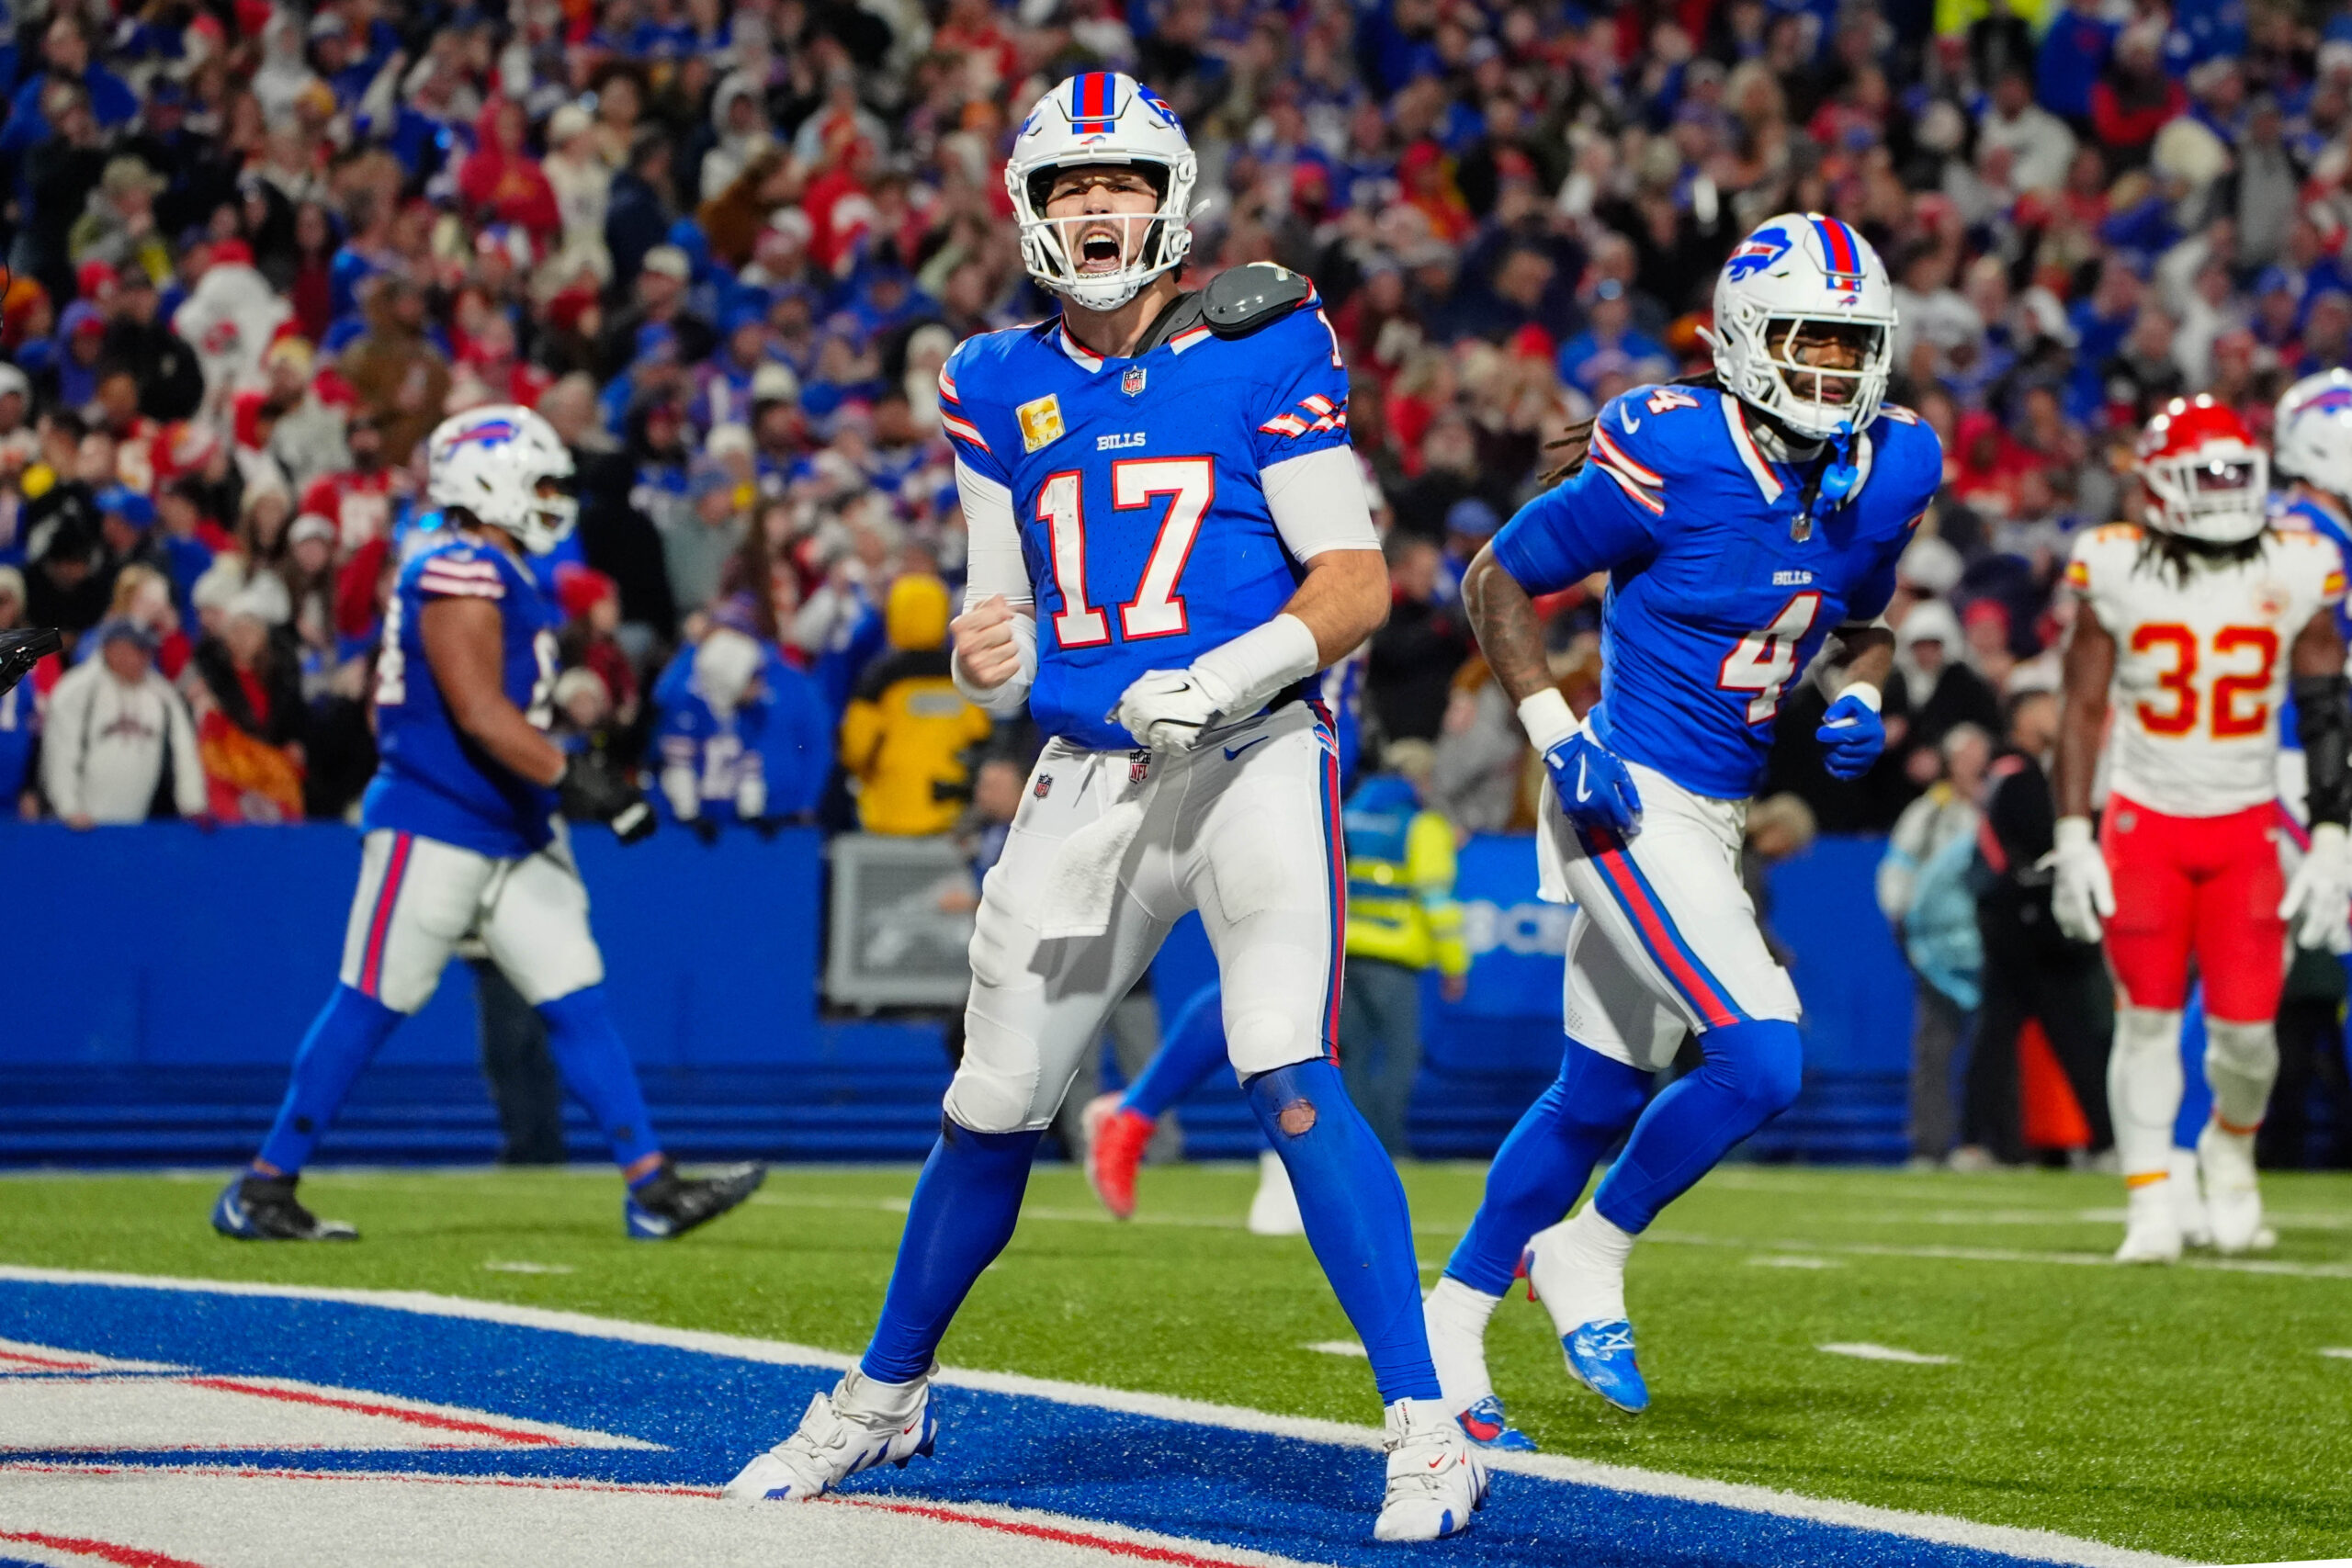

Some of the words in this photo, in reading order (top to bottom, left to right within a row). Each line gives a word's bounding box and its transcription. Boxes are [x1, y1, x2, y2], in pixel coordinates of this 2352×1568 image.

[1645, 389, 1702, 416] 4
[1096, 432, 1147, 451] BILLS
[1035, 454, 1215, 651] 17
[1772, 570, 1813, 585] BILLS
[1717, 590, 1823, 727] 4
[2131, 621, 2279, 740] 32
[1131, 763, 1148, 781] NFL
